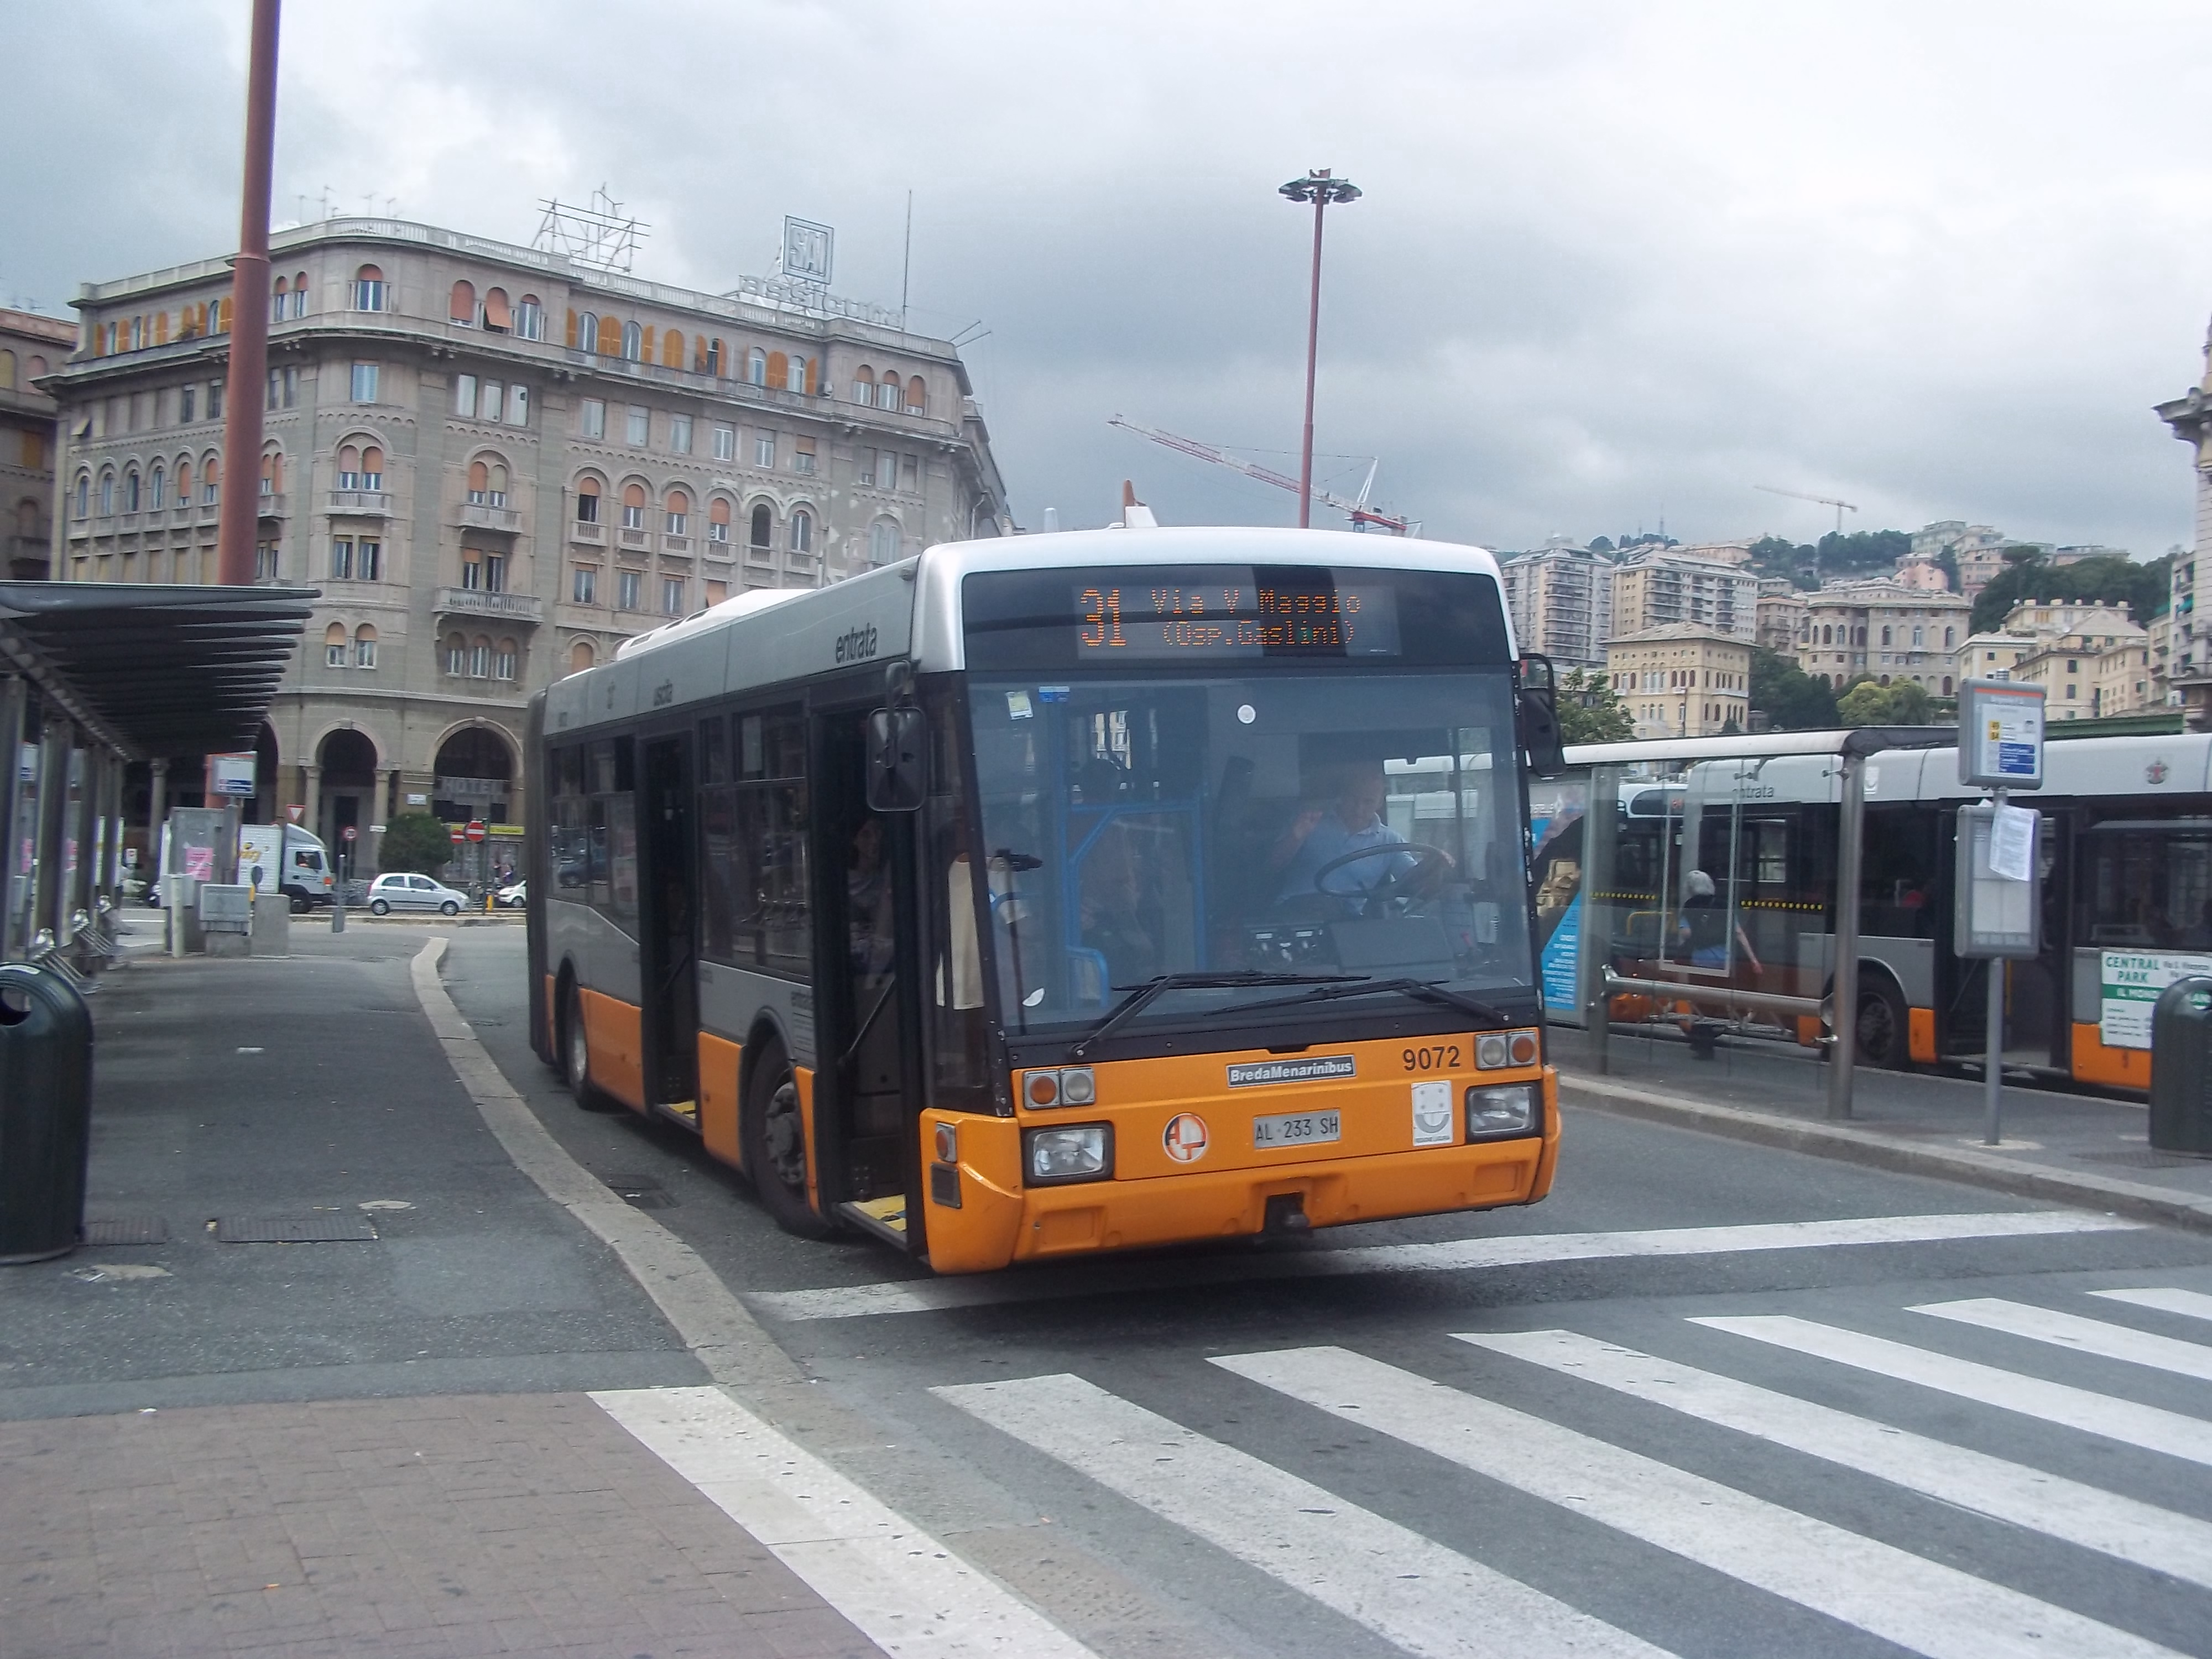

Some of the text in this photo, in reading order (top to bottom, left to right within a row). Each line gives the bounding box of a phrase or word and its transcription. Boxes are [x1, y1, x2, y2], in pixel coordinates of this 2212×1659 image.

[1151, 588, 1204, 614] Via
[1259, 588, 1361, 614] Maggio
[1080, 588, 1126, 646] 31
[835, 622, 877, 664] entrata
[1163, 619, 1354, 646] (Osp.Gaslini)
[2106, 956, 2159, 971] CENTRAL
[2117, 970, 2149, 983] PARK
[1403, 1045, 1460, 1071] 9072
[1230, 1061, 1352, 1082] BredaMenarinibus
[1255, 1115, 1339, 1141] AL 233 SH
